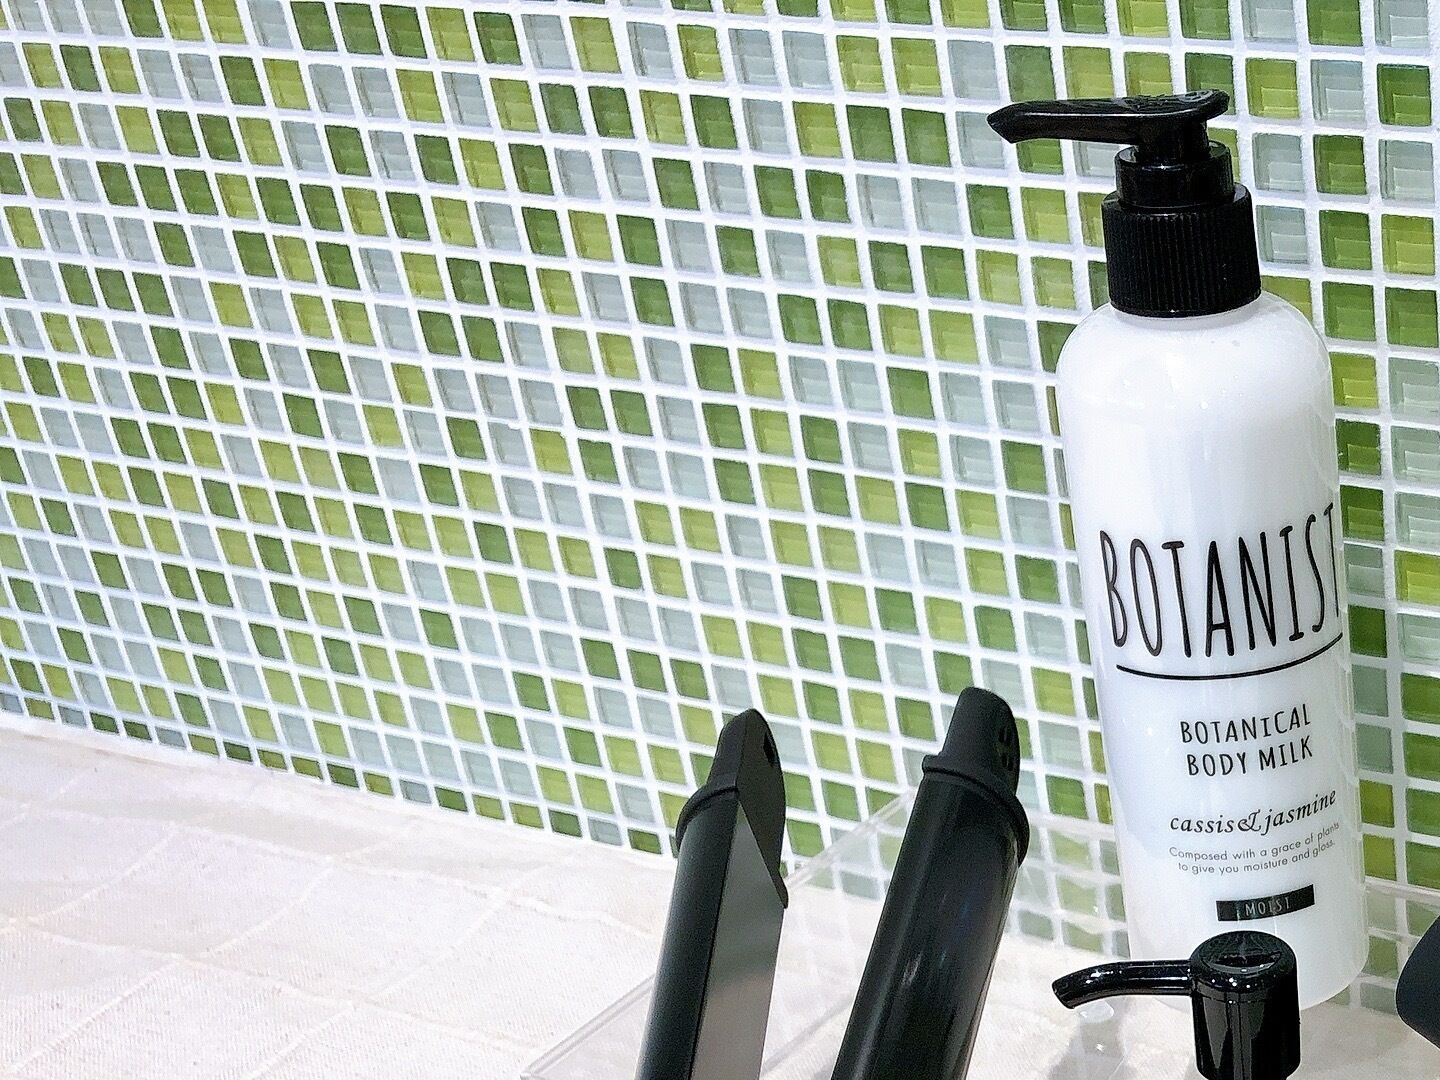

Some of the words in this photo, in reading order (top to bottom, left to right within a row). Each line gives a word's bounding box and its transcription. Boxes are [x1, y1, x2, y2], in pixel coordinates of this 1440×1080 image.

[1099, 502, 1341, 657] BOTANIST
[1179, 703, 1311, 745] BOTANICAL
[1186, 752, 1247, 776] BODY
[1259, 735, 1313, 771] MILK
[1169, 846, 1228, 862] Composed
[1232, 849, 1256, 860] with
[1259, 849, 1267, 858] a
[1271, 841, 1301, 858] grace
[1304, 833, 1314, 845] of
[1178, 862, 1189, 872] to
[1192, 864, 1215, 875] give
[1218, 866, 1239, 876] you
[1243, 858, 1288, 872] moisture
[1291, 847, 1310, 863] and
[1245, 896, 1291, 916] MOIST
